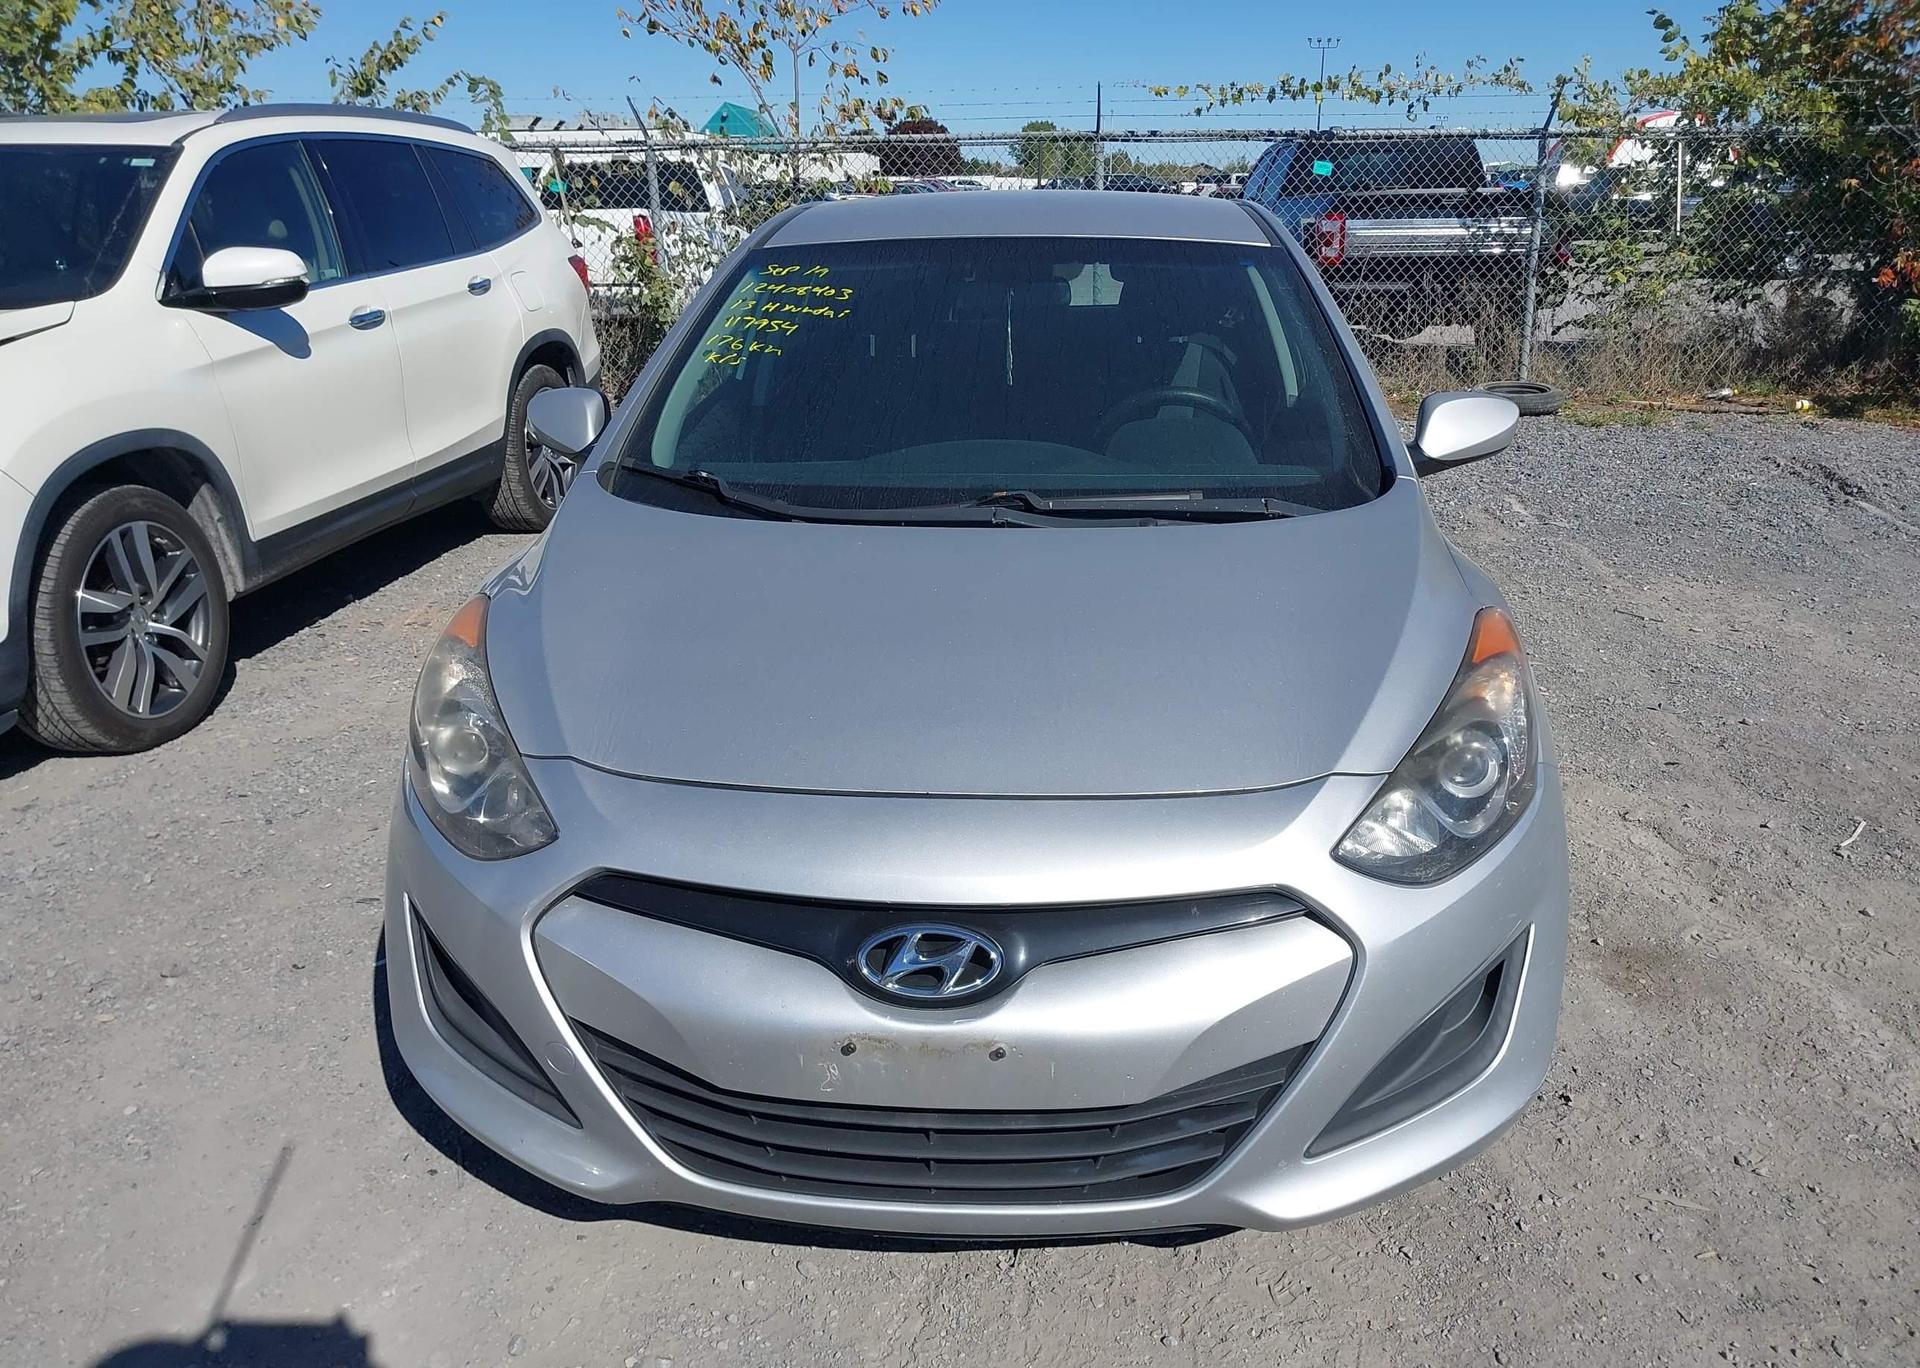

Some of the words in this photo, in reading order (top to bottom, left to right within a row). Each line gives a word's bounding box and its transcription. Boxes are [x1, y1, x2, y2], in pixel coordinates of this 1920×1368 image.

[740, 281, 854, 300] 12408403
[730, 298, 757, 310] 13
[724, 315, 799, 336] 117954
[706, 334, 744, 350] 176
